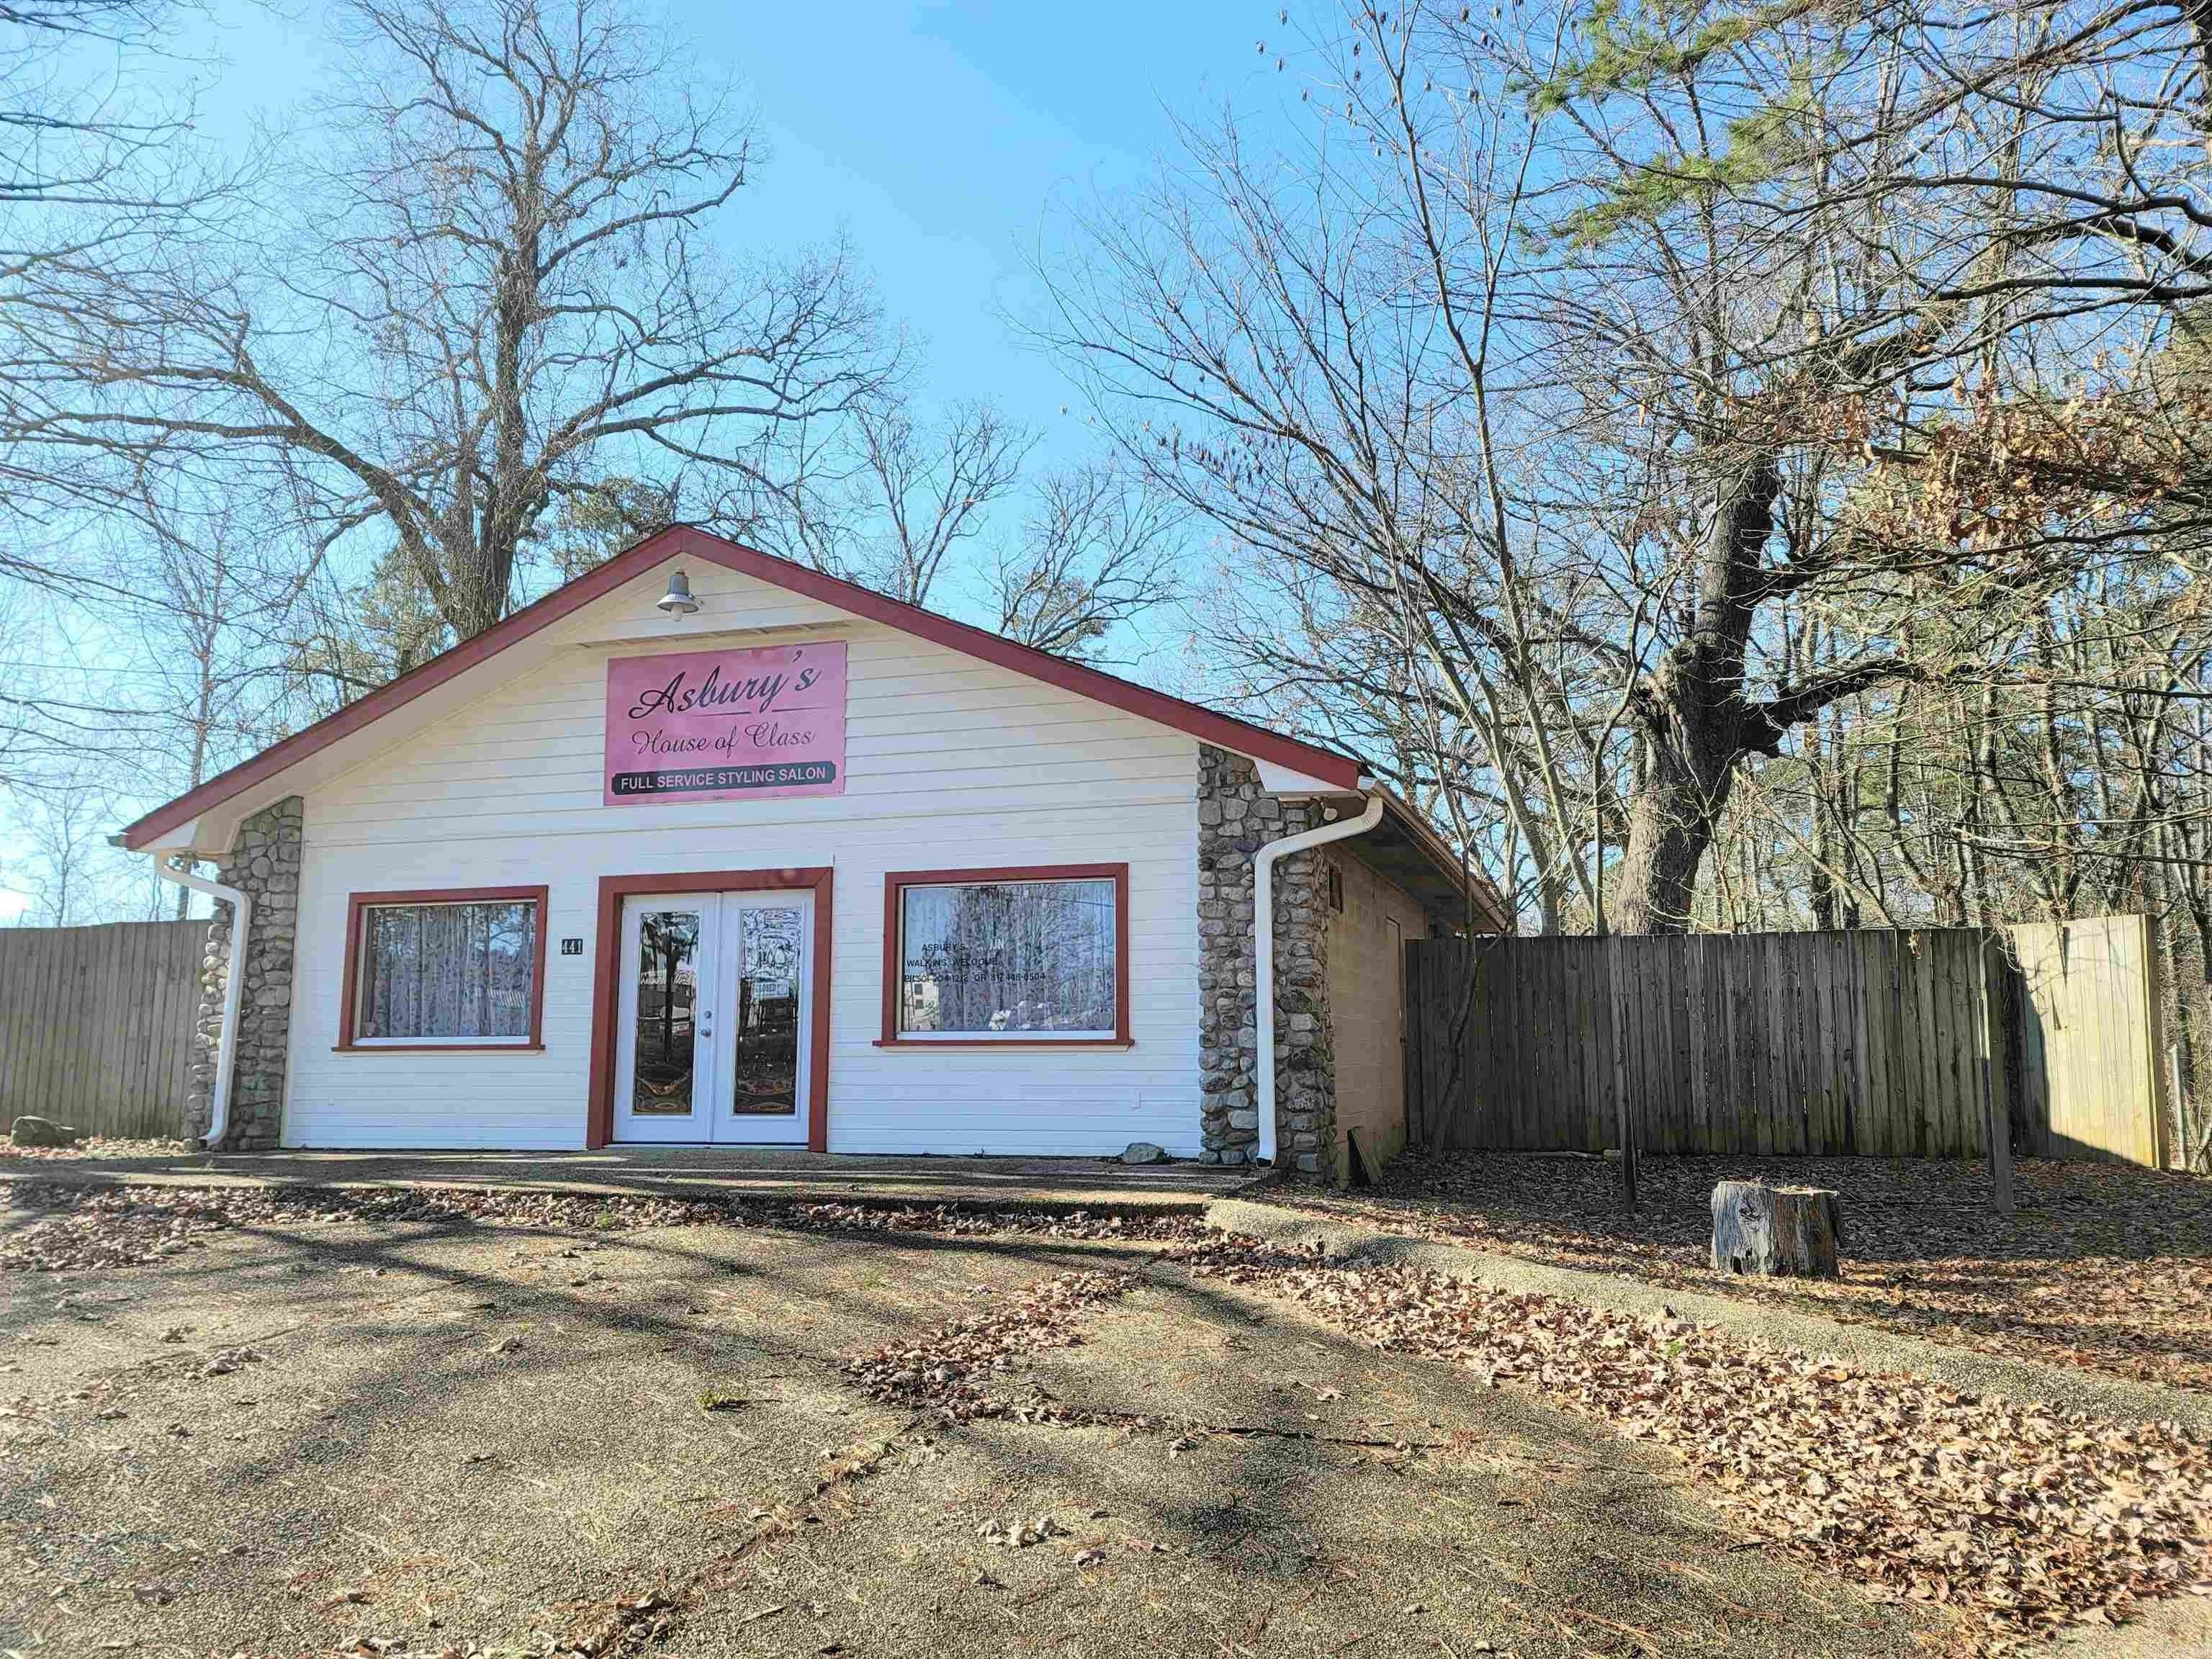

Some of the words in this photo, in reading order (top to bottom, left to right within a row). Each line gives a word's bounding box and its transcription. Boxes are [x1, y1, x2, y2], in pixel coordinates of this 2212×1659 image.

[628, 650, 822, 719] Asbury's
[632, 729, 710, 755] House
[714, 726, 739, 757] of
[745, 722, 815, 747] Class
[621, 776, 653, 790] FULL
[657, 773, 714, 788] SERVICE
[719, 770, 775, 785] STYLING
[778, 766, 826, 781] SALON
[562, 939, 582, 953] 441
